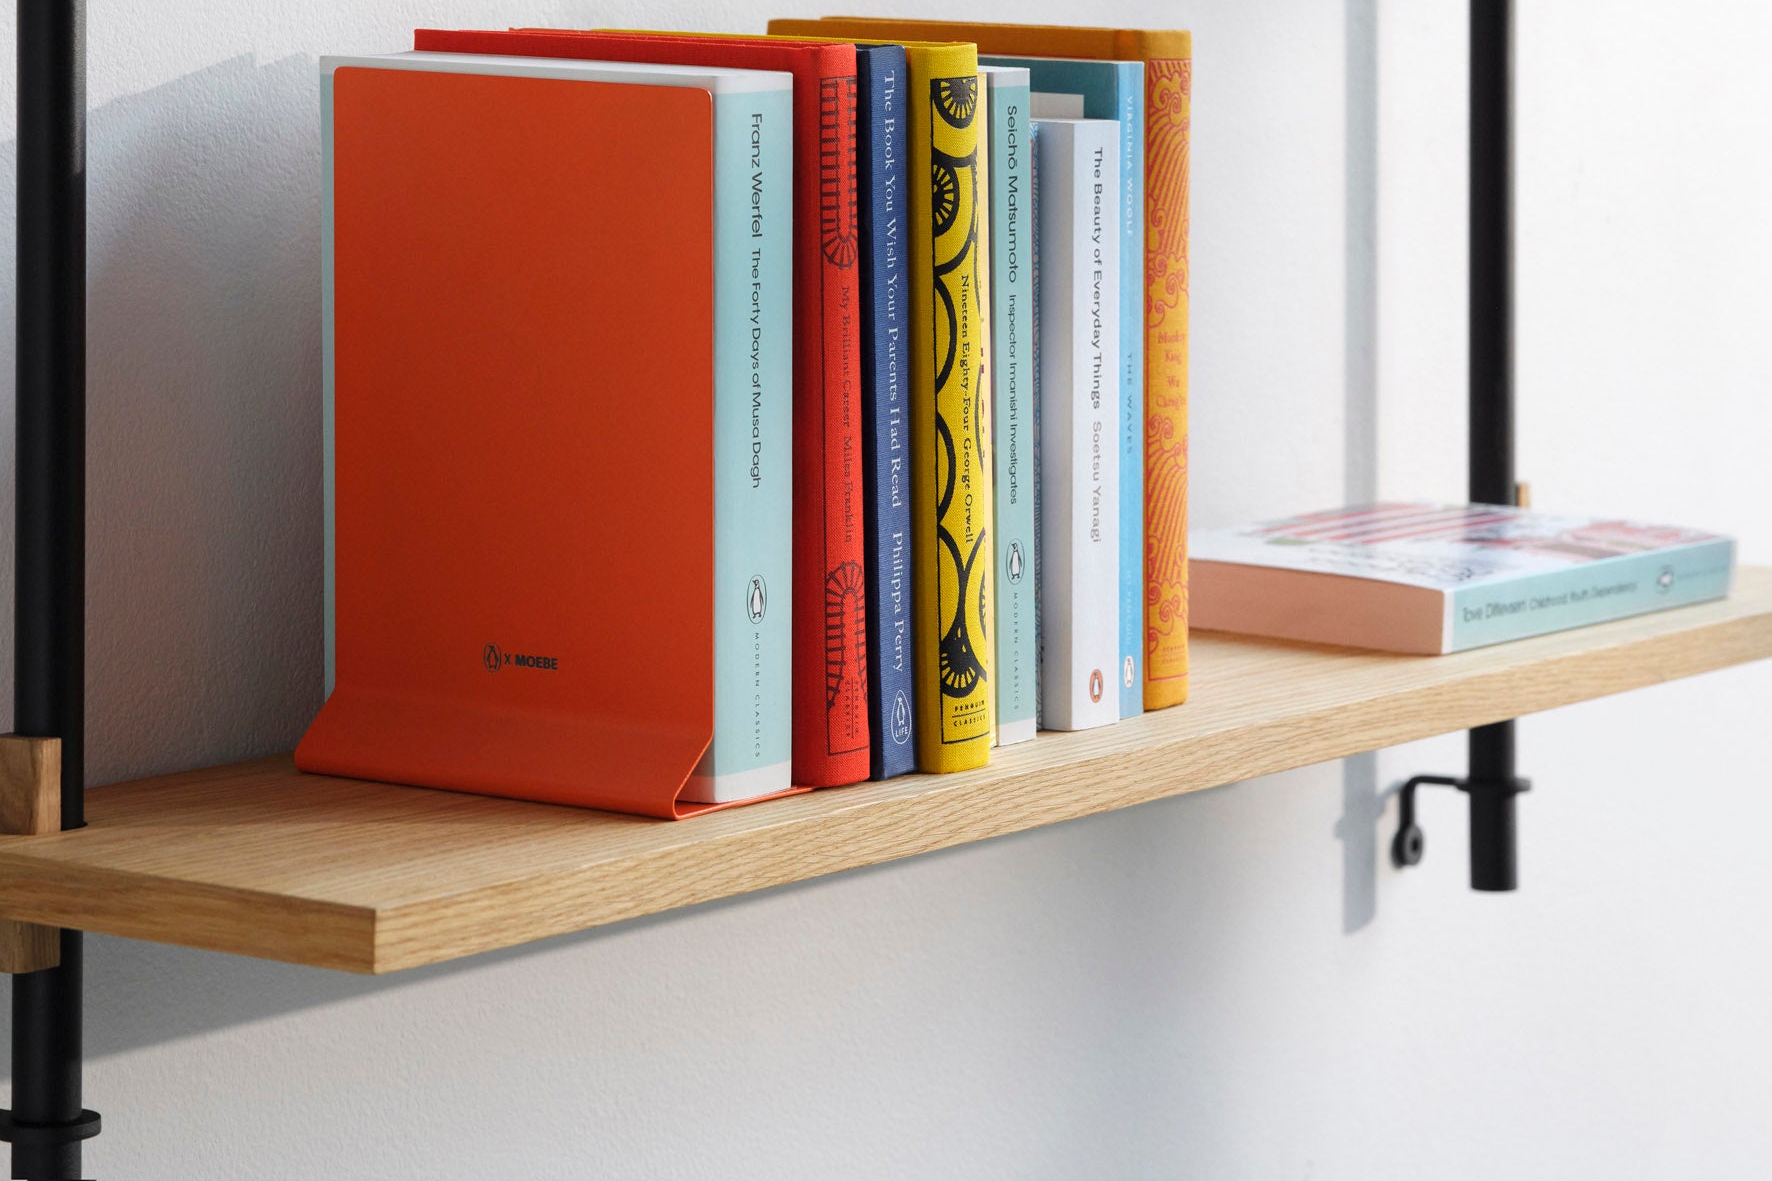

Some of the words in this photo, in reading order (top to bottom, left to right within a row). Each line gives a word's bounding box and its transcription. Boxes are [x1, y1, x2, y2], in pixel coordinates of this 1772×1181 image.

[884, 70, 895, 112] The
[751, 113, 763, 169] Franz
[884, 118, 896, 171] Book
[1007, 105, 1018, 170] Seichō
[1126, 95, 1134, 170] VIRGINIA
[1093, 147, 1103, 179] The
[751, 172, 763, 238] Werfel
[885, 175, 896, 212] You
[1091, 183, 1103, 244] Beauty
[1126, 178, 1134, 236] WOOLF
[886, 218, 897, 269] Wish
[1008, 176, 1018, 283] Matsumoto
[751, 248, 761, 280] The
[1093, 247, 1103, 266] of
[750, 282, 761, 325] Forty
[840, 287, 850, 309] My
[887, 274, 898, 320] Your
[961, 275, 969, 338] Nineteen
[1090, 269, 1102, 350] Everyday
[750, 328, 761, 370] Days
[842, 315, 851, 378] Brilliant
[1008, 294, 1017, 360] Inspector
[752, 372, 762, 389] of
[887, 327, 899, 401] Parents
[959, 342, 970, 431] Eighty-Four
[1090, 353, 1102, 410] Things
[752, 391, 762, 439] Musa
[842, 379, 852, 428] Career
[1009, 362, 1018, 421] Imanishi
[889, 407, 900, 451] Had
[1091, 421, 1102, 482] Soetsu
[750, 442, 762, 489] Dagh
[843, 436, 852, 480] Miles
[891, 458, 902, 508] Read
[963, 438, 972, 491] George
[1008, 423, 1018, 505] Investigates
[844, 480, 854, 544] Franklin
[964, 493, 974, 544] Orwell
[1090, 485, 1102, 543] Yanagi
[891, 532, 903, 615] Philippa
[514, 654, 558, 670] MOEBE
[892, 619, 905, 672] Perry
[895, 726, 908, 738] LIFE
[953, 714, 986, 727] CLASSICS
[954, 700, 985, 712] PENGUIN
